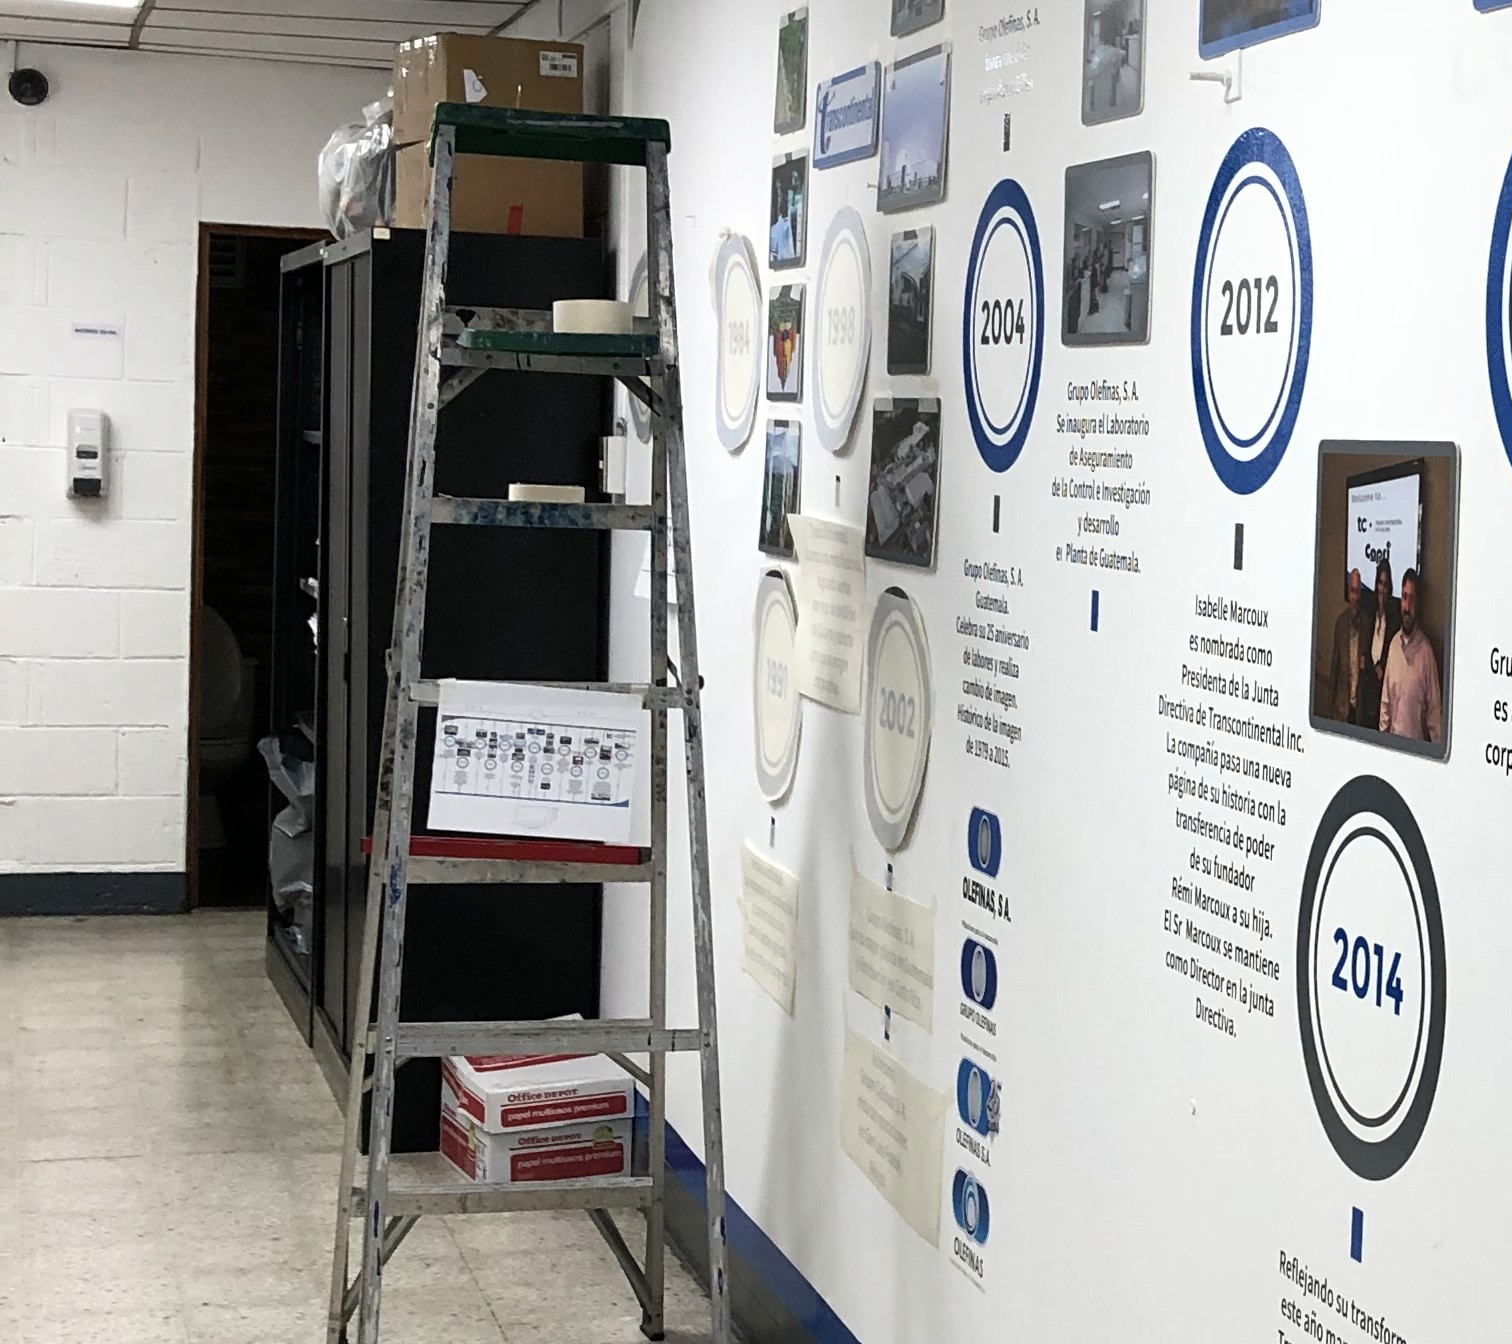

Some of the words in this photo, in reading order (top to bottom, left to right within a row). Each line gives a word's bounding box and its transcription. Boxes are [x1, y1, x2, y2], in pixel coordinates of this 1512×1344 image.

[980, 299, 1025, 345] 2004
[1220, 275, 1279, 336] 2012
[1195, 595, 1228, 621] Isabelle
[1230, 600, 1268, 628] Marcoux
[1189, 634, 1198, 652] es
[1200, 634, 1244, 661] nombrada
[1247, 646, 1272, 667] como
[1182, 664, 1226, 694] Presidenta
[1229, 673, 1239, 698] de
[1242, 676, 1249, 700] la
[1252, 680, 1279, 707] Junta
[879, 686, 915, 739] 2002
[1159, 694, 1194, 723] Directiva
[1196, 703, 1206, 726] de
[1208, 707, 1284, 748] Transcontinental
[1287, 727, 1304, 753] Inc.
[1494, 700, 1508, 722] es
[1331, 927, 1404, 1016] 2014
[1280, 1250, 1334, 1308] Reflejando
[1336, 1294, 1348, 1319] su
